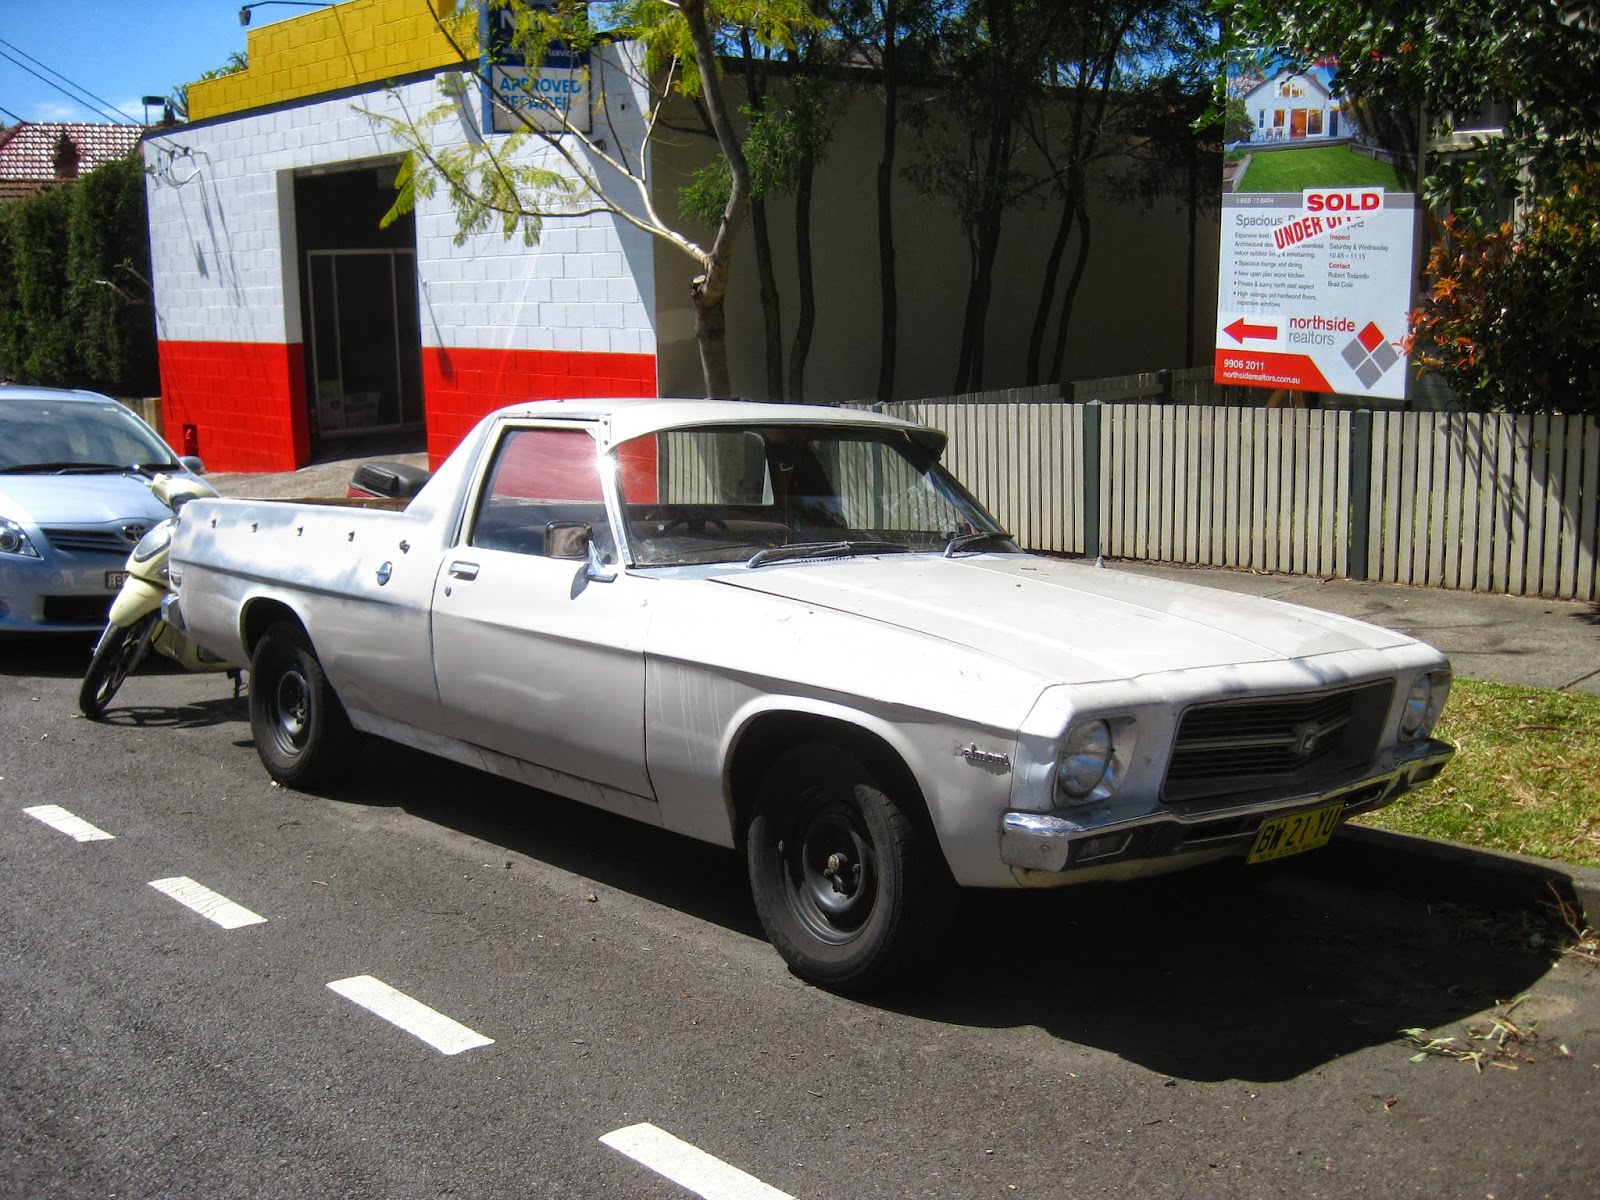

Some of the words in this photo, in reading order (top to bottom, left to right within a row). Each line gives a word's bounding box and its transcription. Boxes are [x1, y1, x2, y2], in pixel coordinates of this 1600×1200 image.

[1307, 193, 1380, 212] SOLD
[1236, 214, 1283, 228] Spacious
[1273, 216, 1323, 249] UNDER
[1329, 243, 1352, 251] Saturday
[1358, 244, 1389, 252] Wednesday
[1260, 261, 1277, 269] lounge
[1289, 315, 1356, 332] northside
[1288, 330, 1335, 346] realtors
[1223, 359, 1244, 369] 9906
[1245, 360, 1265, 370] 2011
[1222, 371, 1301, 384] northsiderealtors.com.au
